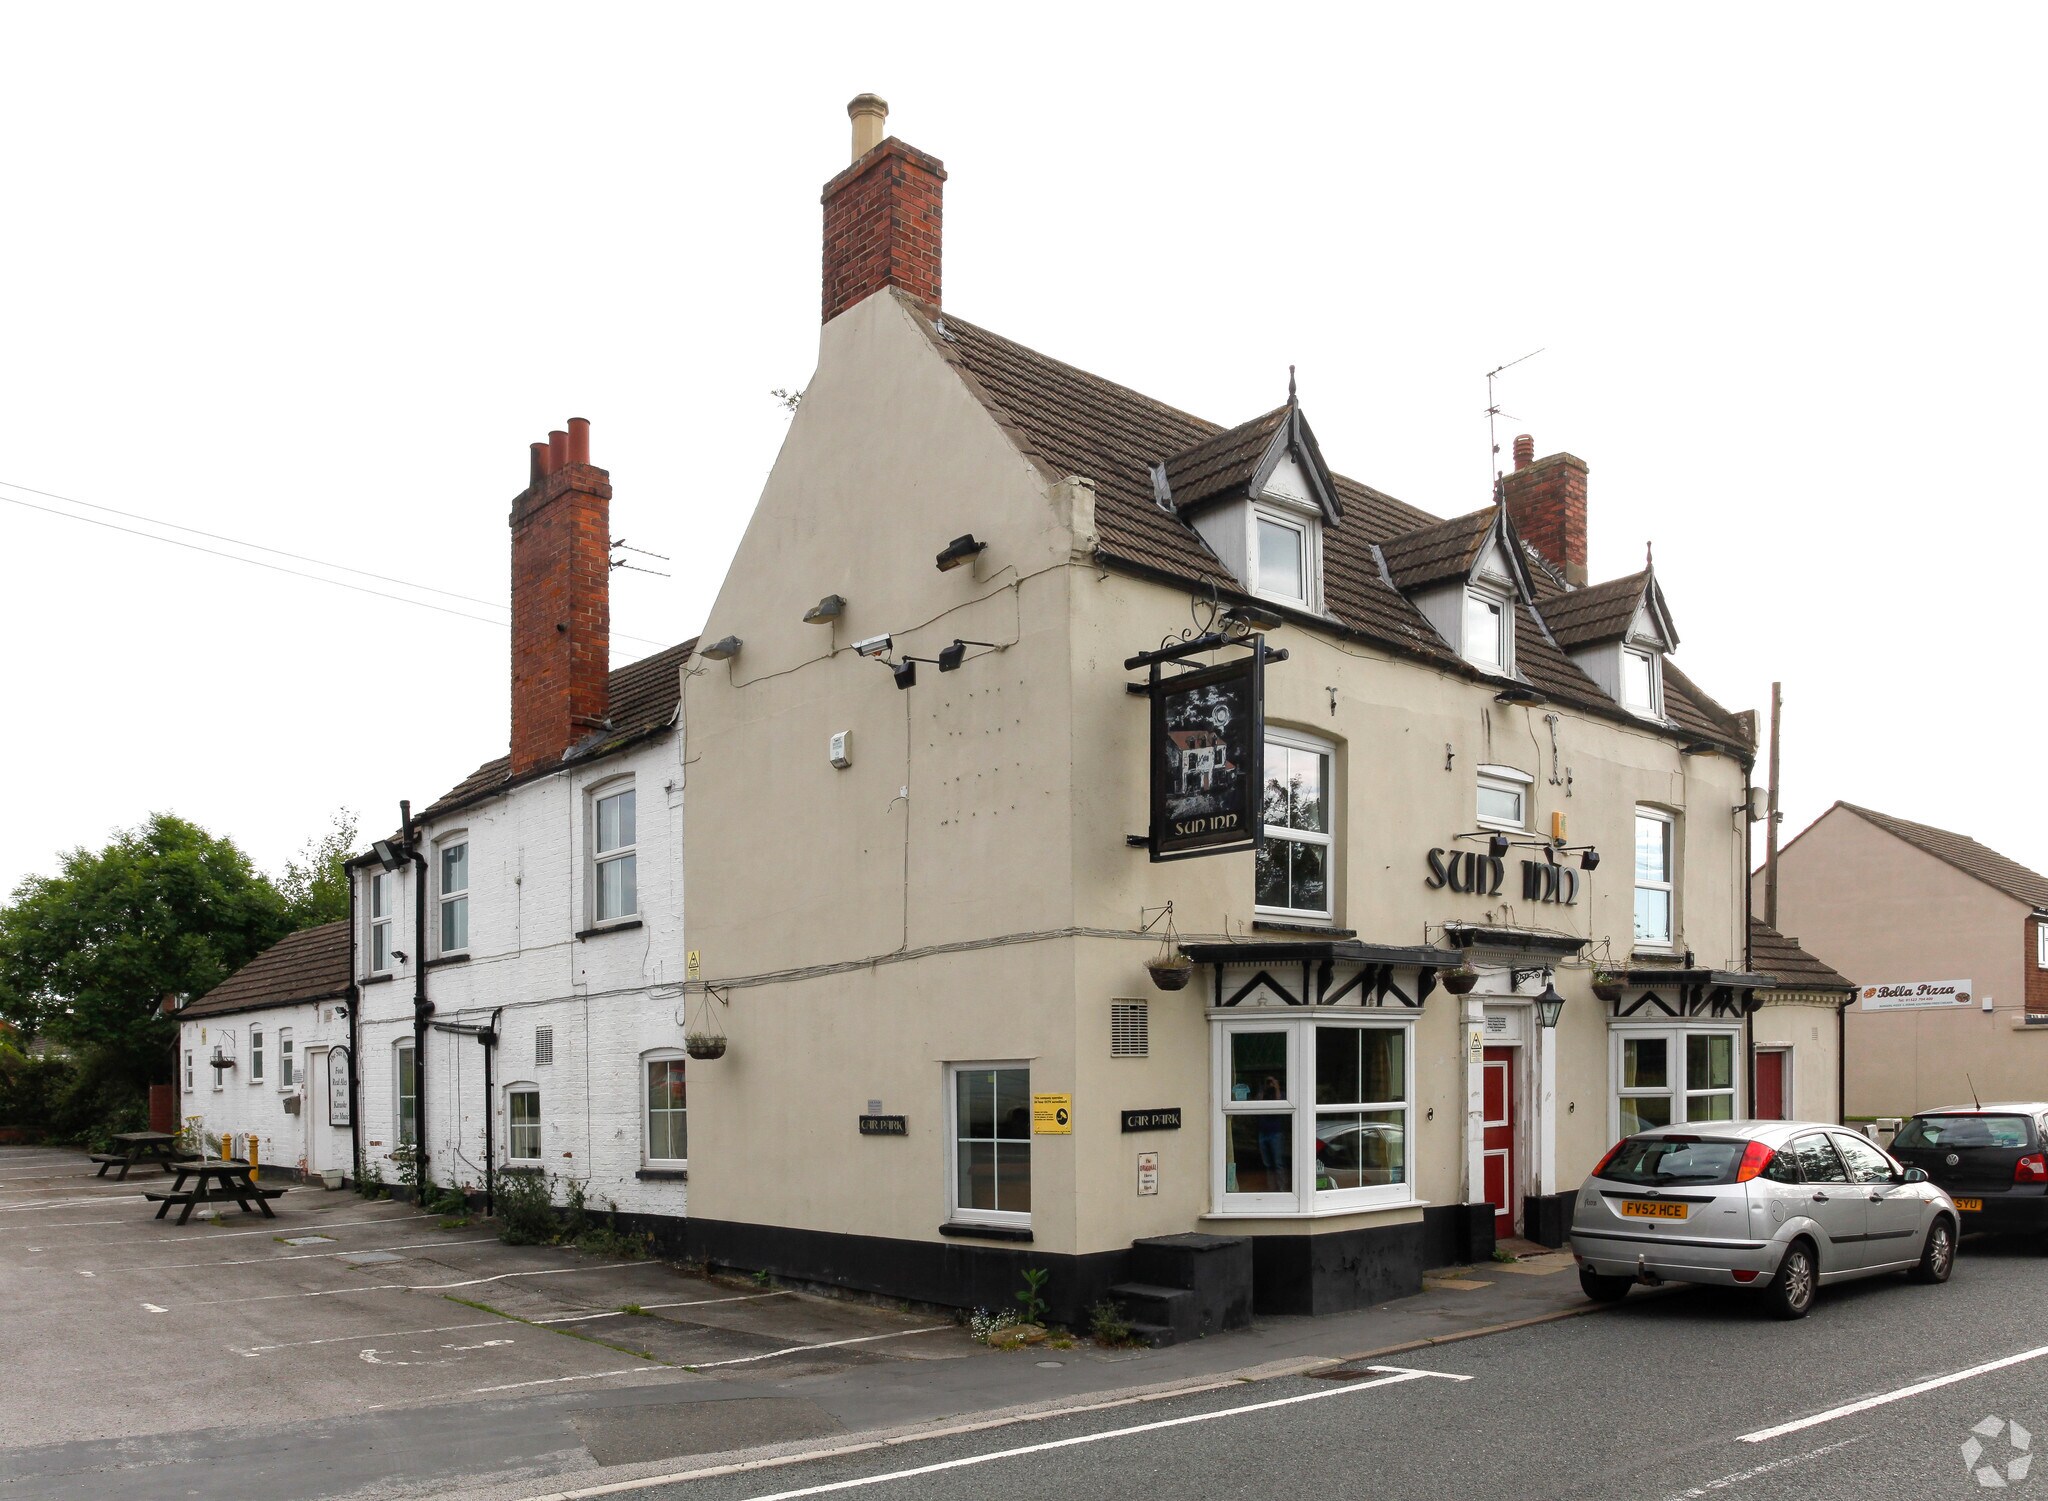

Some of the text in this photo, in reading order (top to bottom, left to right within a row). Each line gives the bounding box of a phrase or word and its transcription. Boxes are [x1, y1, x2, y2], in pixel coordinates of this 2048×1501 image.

[1877, 984, 1956, 998] Bella Pizza
[861, 1119, 903, 1130] CAR PARK
[1128, 1113, 1180, 1127] CAR PARK
[1627, 1202, 1682, 1217] FV52 HCE
[1956, 1199, 1977, 1208] SYU
